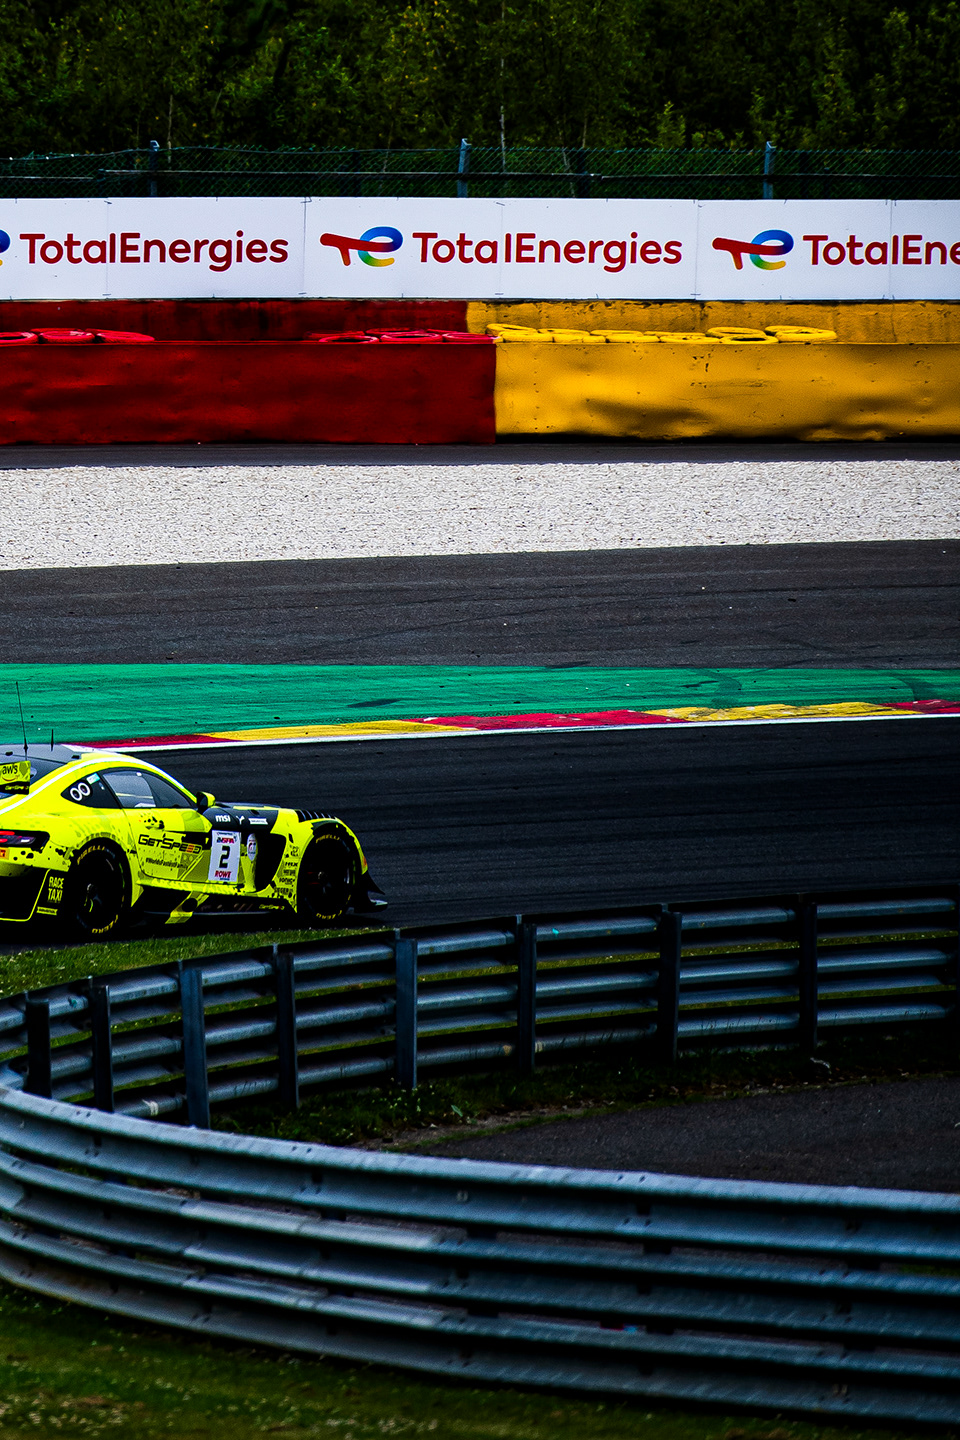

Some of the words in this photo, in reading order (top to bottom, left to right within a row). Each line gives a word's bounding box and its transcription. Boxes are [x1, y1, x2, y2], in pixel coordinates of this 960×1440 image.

[19, 230, 288, 272] TotalEnergies
[412, 232, 682, 273] TotalEnergies
[2, 765, 18, 775] aws
[77, 845, 105, 865] PIRELLI
[219, 845, 230, 868] 2
[214, 870, 231, 878] ROWE
[48, 876, 64, 889] RACE
[48, 888, 63, 901] TAXI
